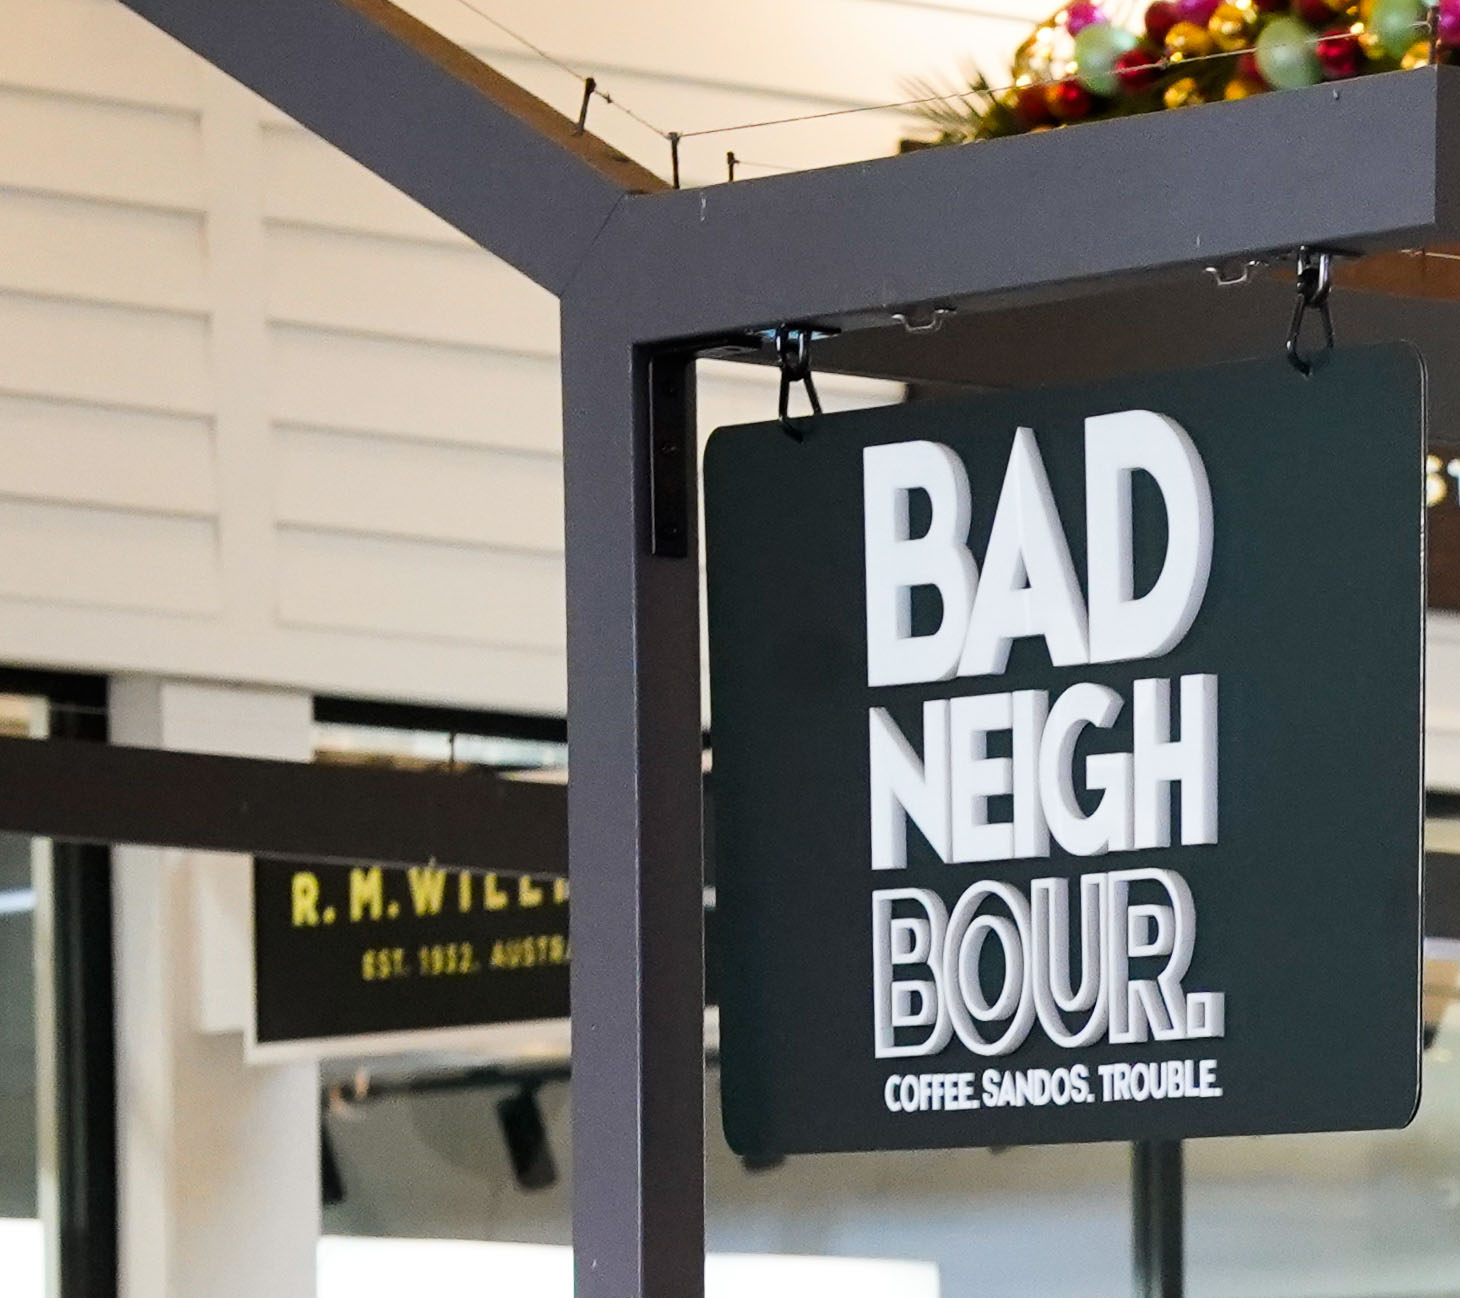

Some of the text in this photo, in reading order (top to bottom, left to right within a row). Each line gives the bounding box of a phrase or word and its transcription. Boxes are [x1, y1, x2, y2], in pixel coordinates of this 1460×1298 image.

[863, 408, 1214, 687] BAD
[868, 673, 1218, 871] NEIGH
[489, 933, 570, 969] AUSTR
[872, 867, 1225, 1059] BOUR.
[884, 1059, 1222, 1112] COFFEE. SANDOS. TROUBLE.
